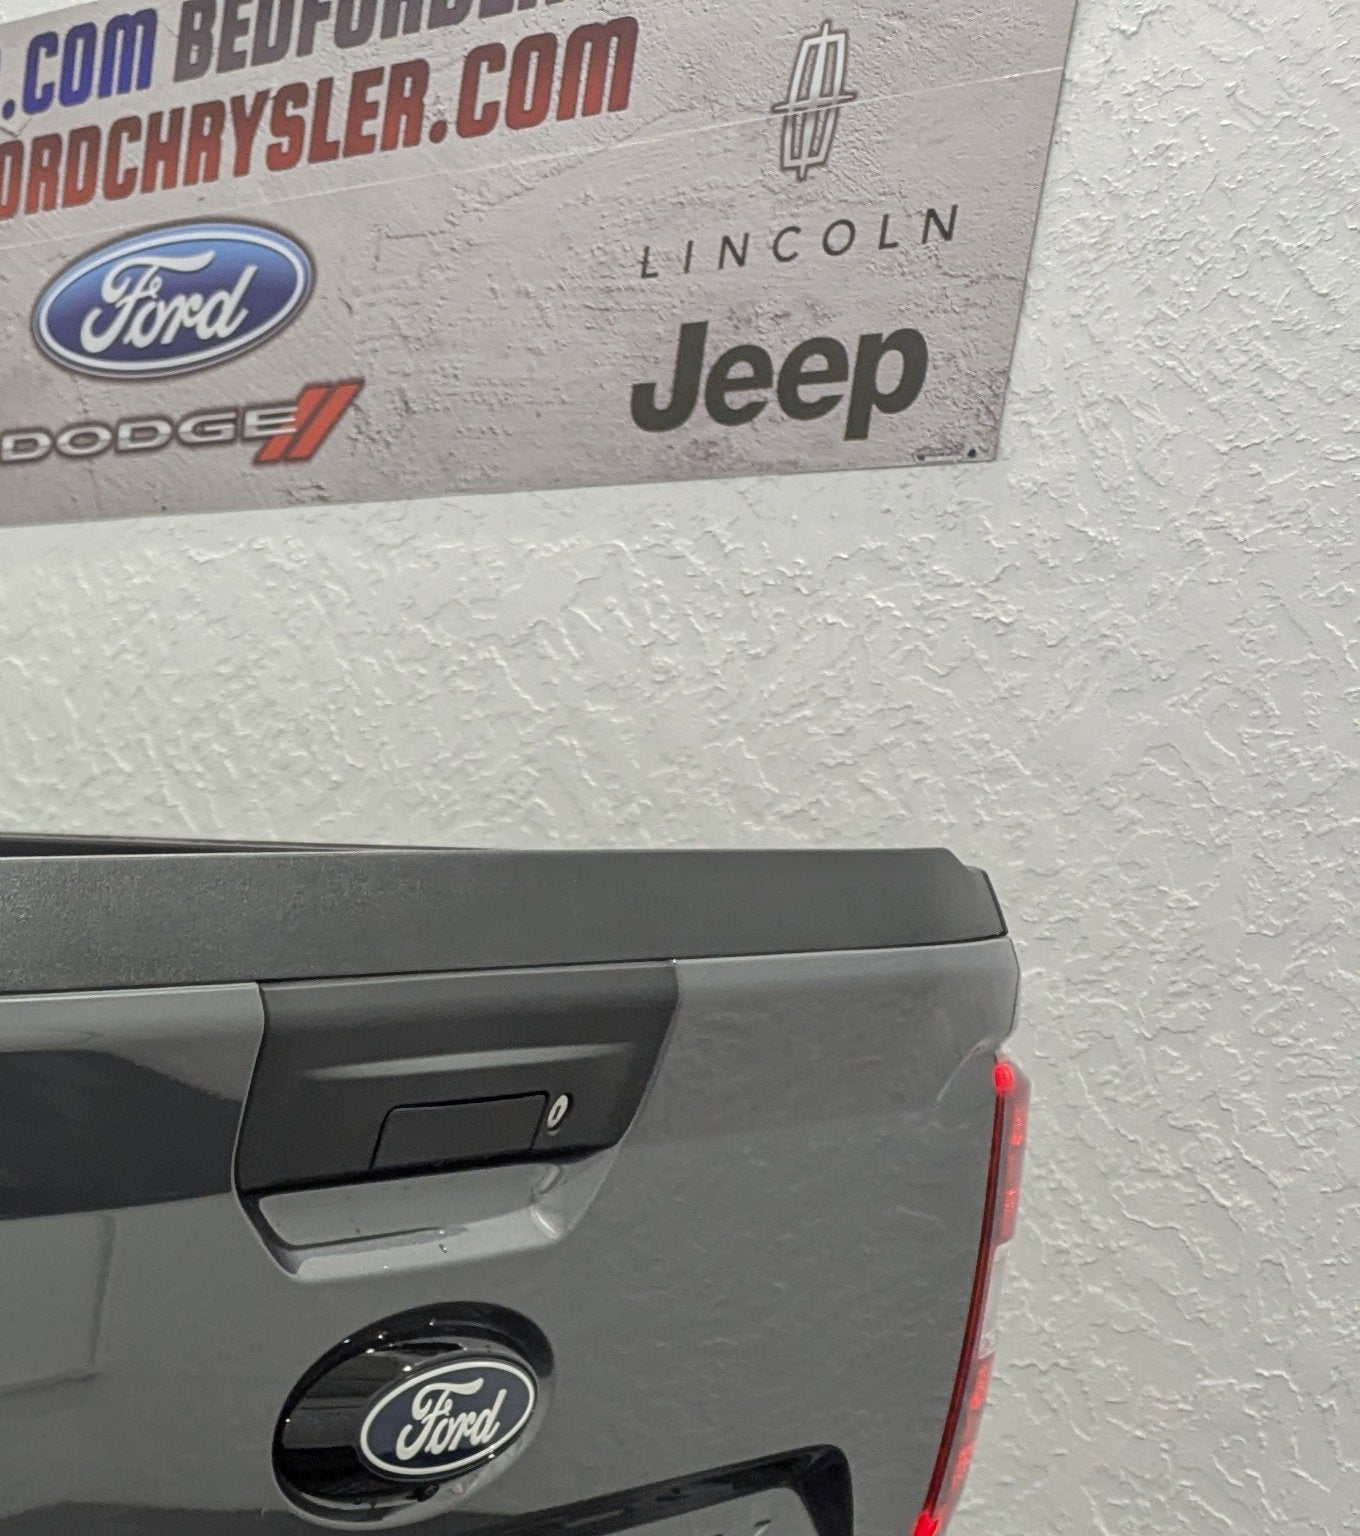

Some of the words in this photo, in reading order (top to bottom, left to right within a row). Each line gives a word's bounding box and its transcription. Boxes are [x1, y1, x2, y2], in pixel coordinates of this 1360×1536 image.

[641, 205, 959, 279] LINCOLN
[80, 251, 259, 353] Ford
[631, 321, 929, 441] Jeep
[395, 1378, 508, 1461] Ford
